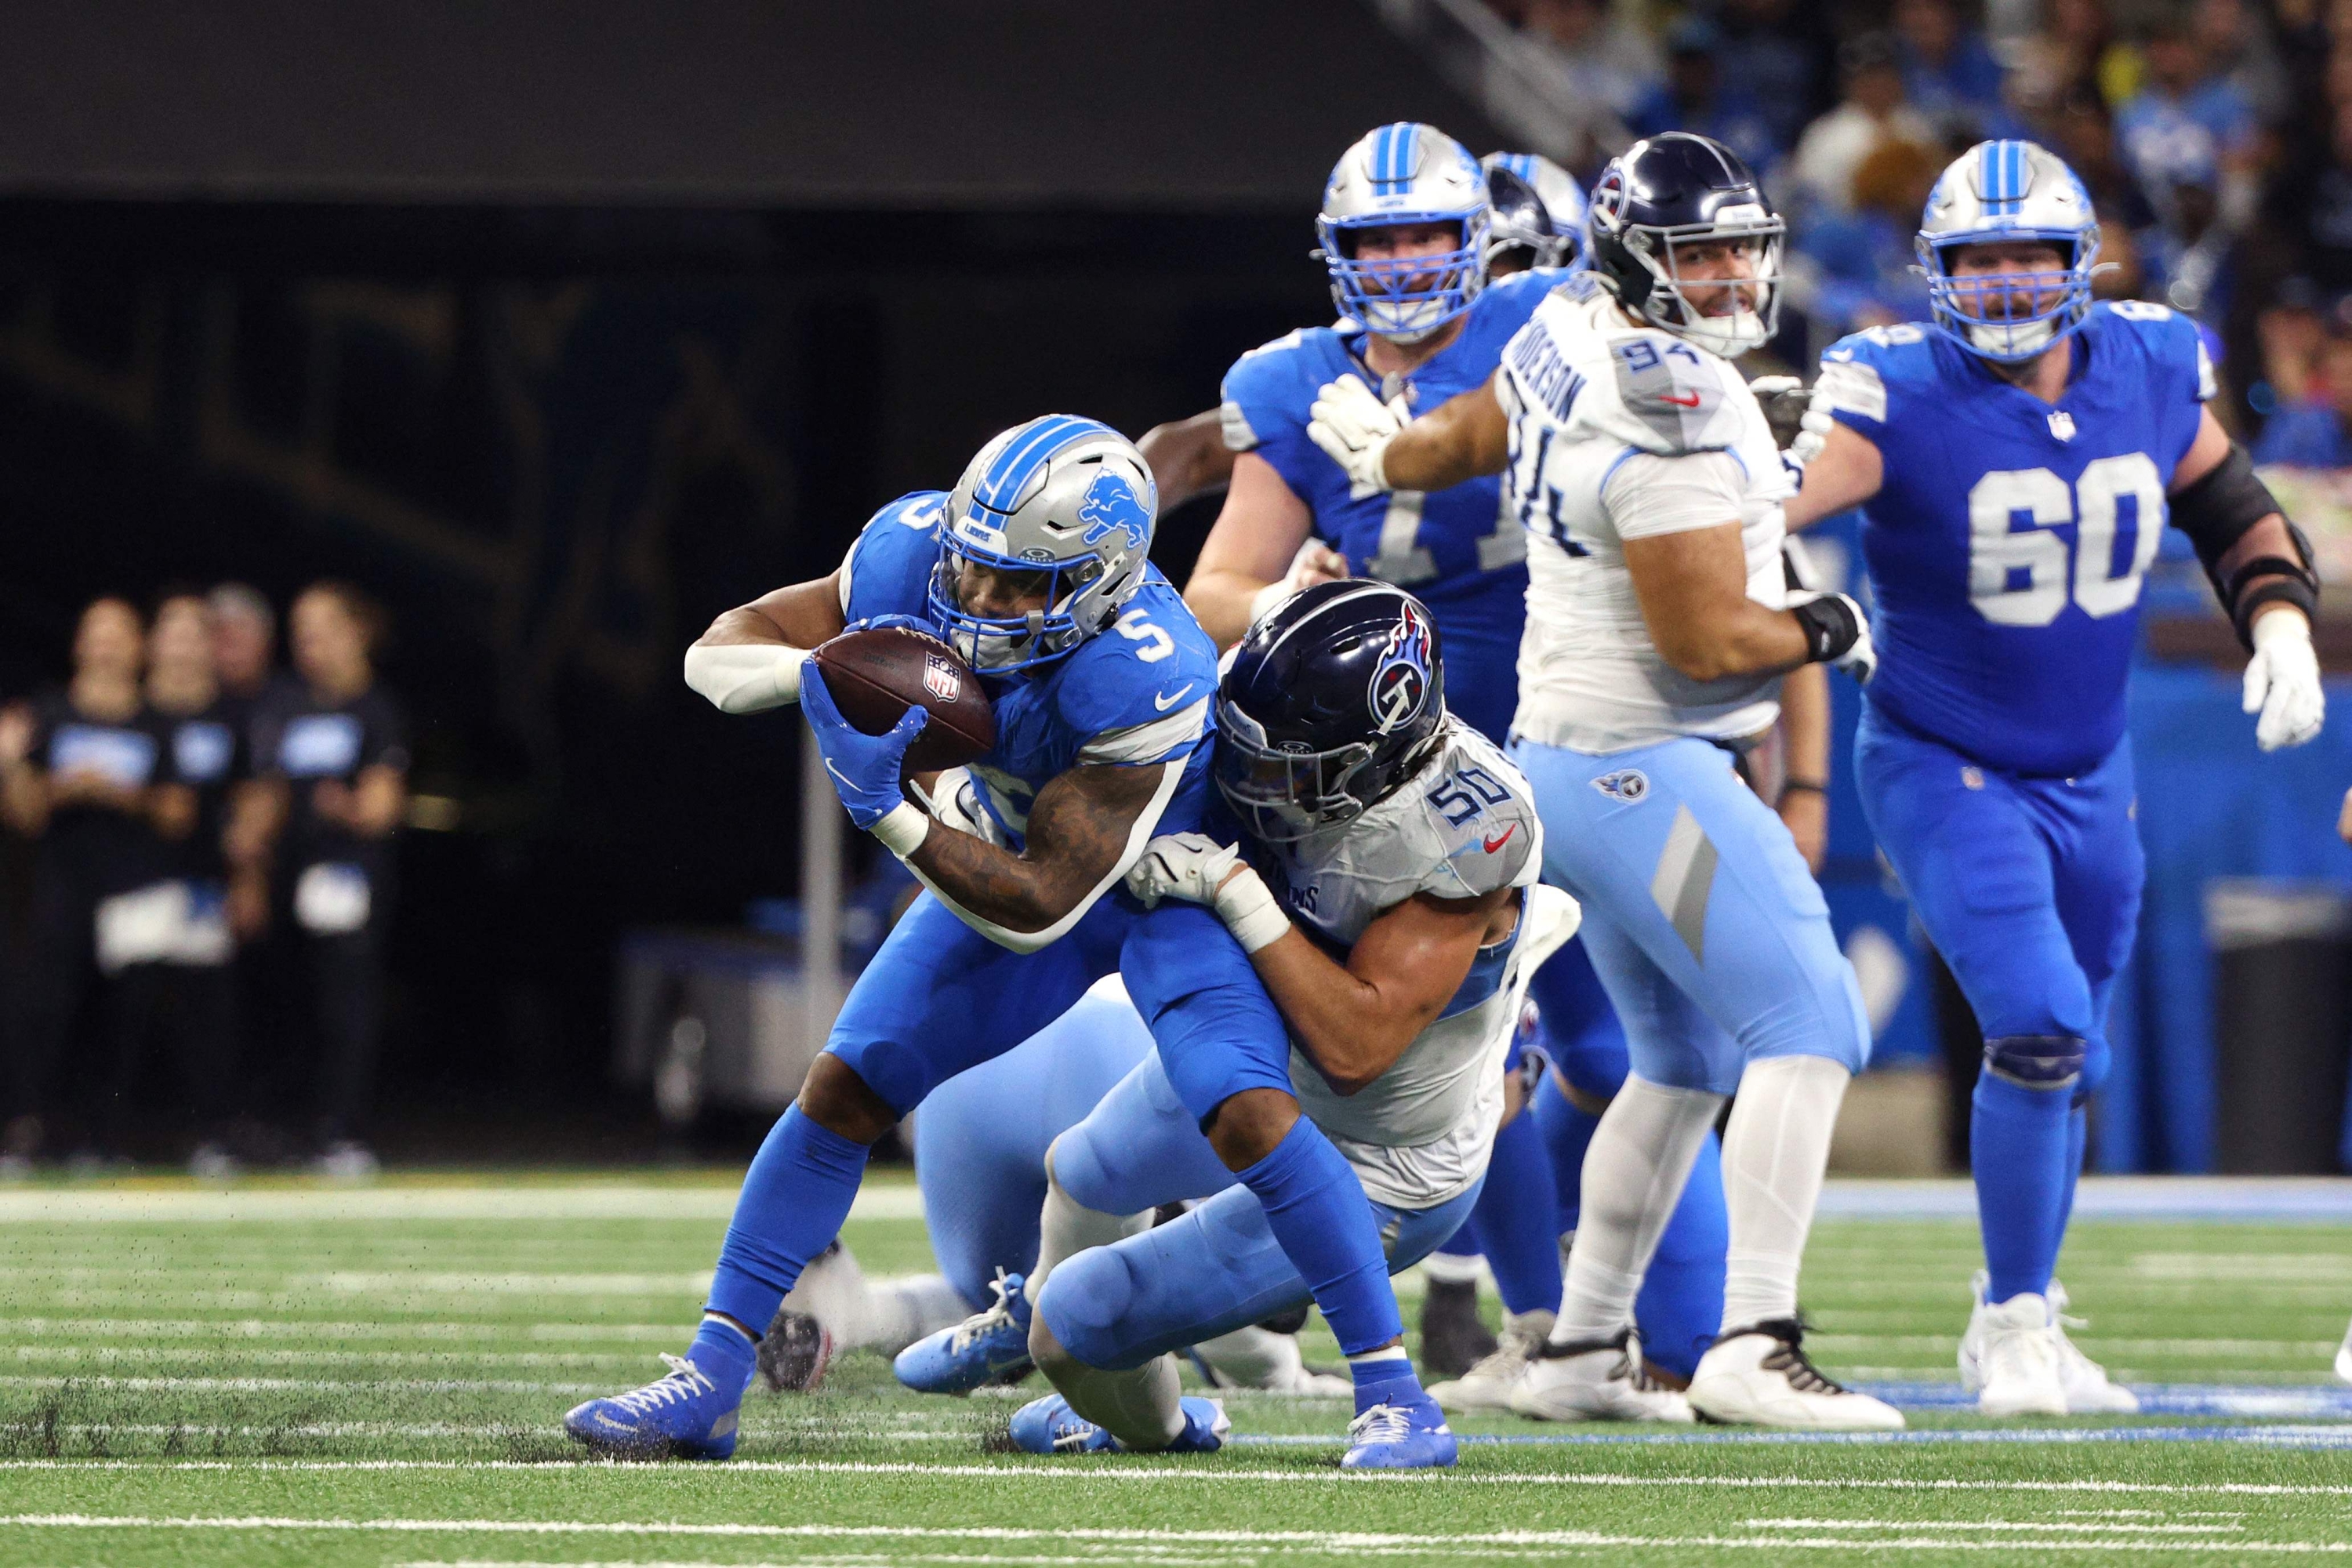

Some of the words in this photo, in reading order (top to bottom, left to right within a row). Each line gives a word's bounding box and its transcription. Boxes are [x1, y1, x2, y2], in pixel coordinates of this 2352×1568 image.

[1967, 450, 2165, 626] 60
[1112, 608, 1174, 664] 5
[928, 669, 955, 698] NFL
[1425, 767, 1513, 831] 50
